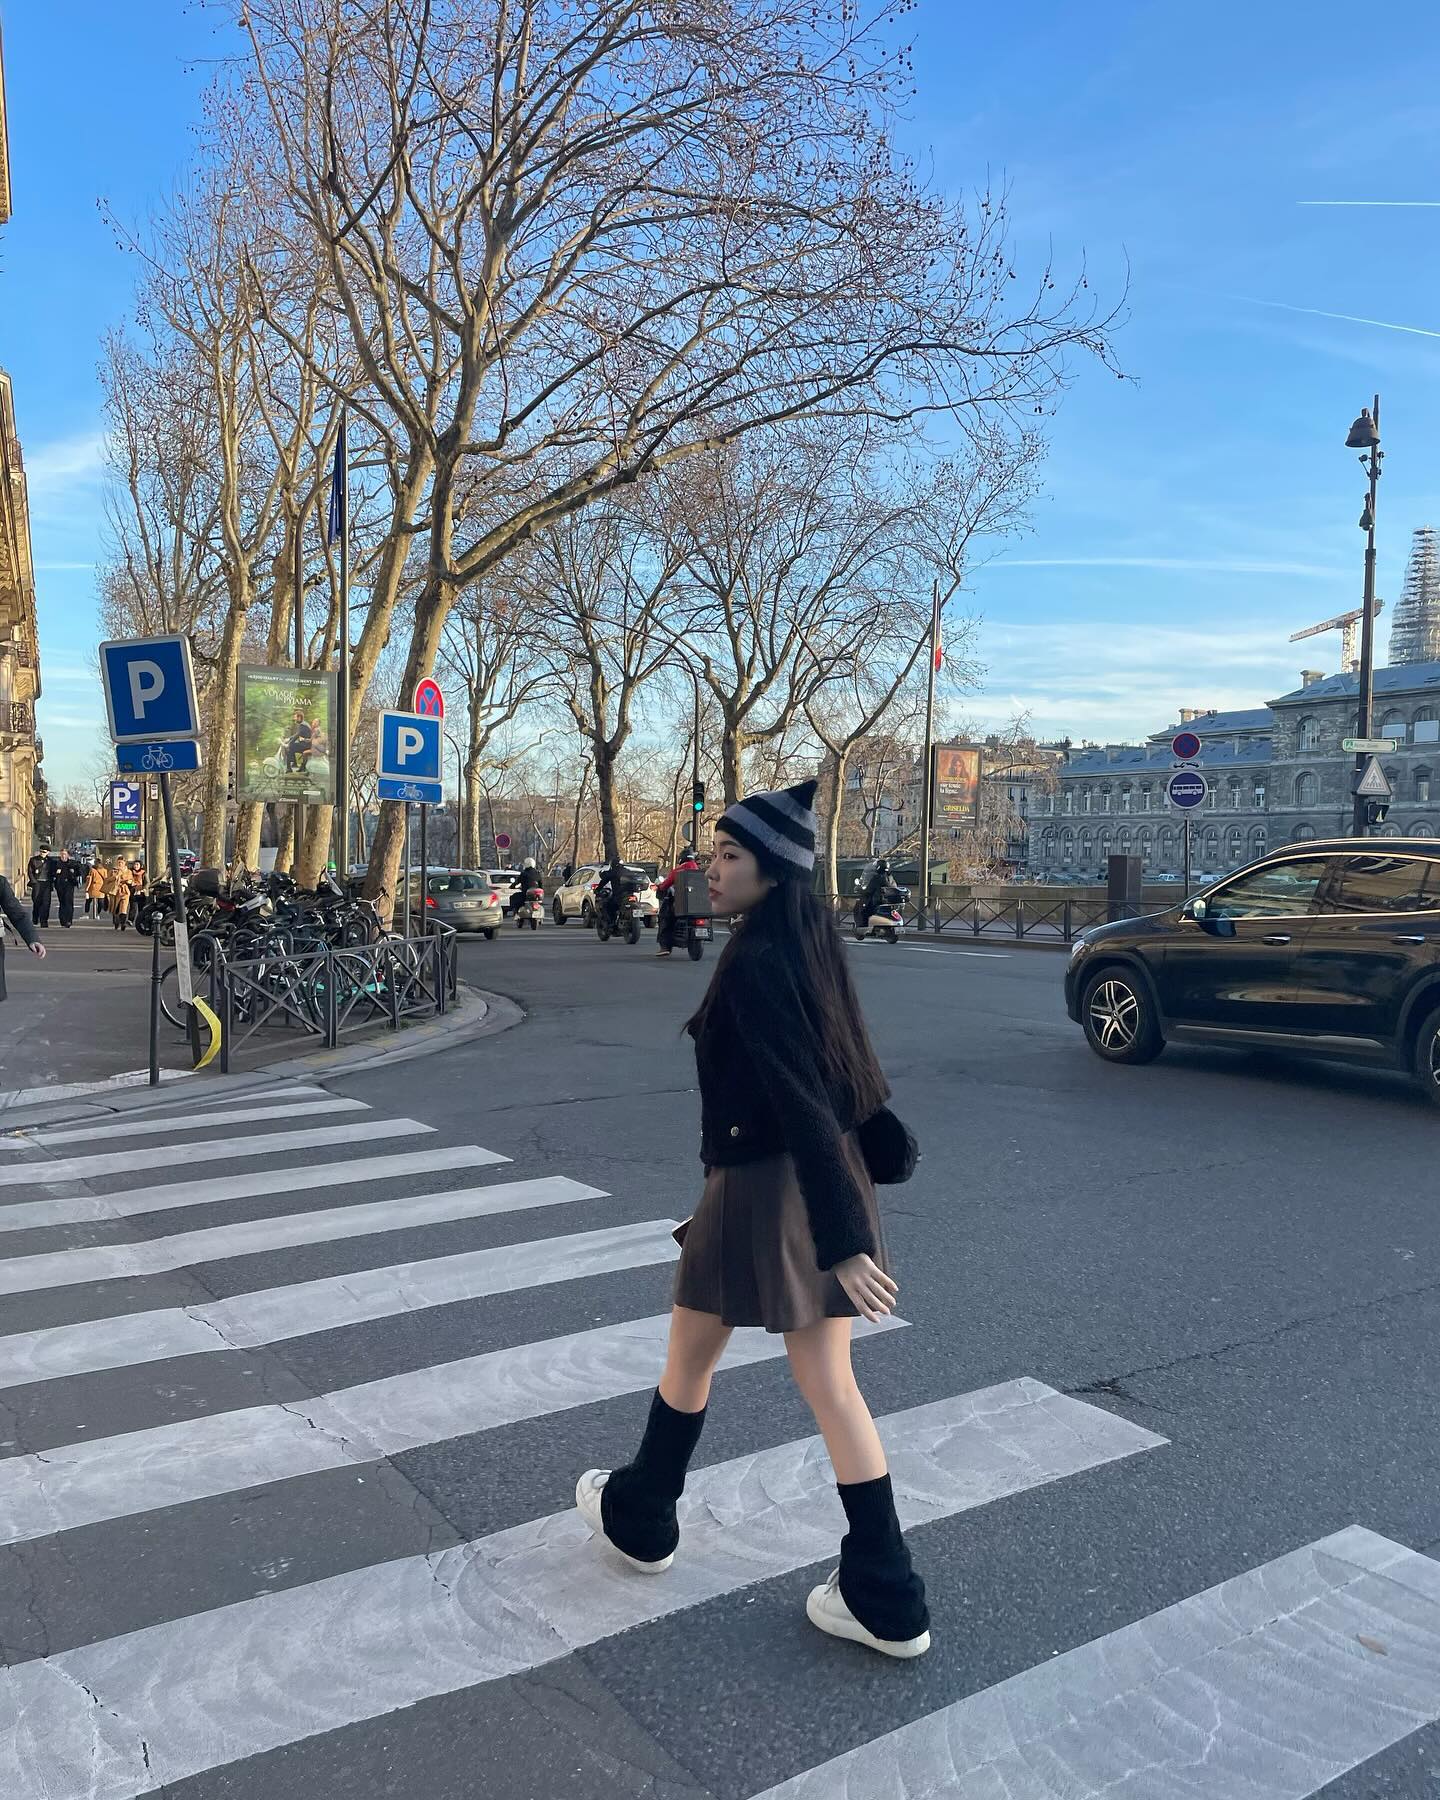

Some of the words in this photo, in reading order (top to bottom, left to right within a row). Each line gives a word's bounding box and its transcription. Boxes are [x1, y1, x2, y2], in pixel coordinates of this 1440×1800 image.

[127, 660, 165, 719] P
[263, 688, 294, 698] VOYAGE
[283, 697, 312, 706] PYJAMA
[397, 726, 424, 765] P
[114, 788, 131, 809] P
